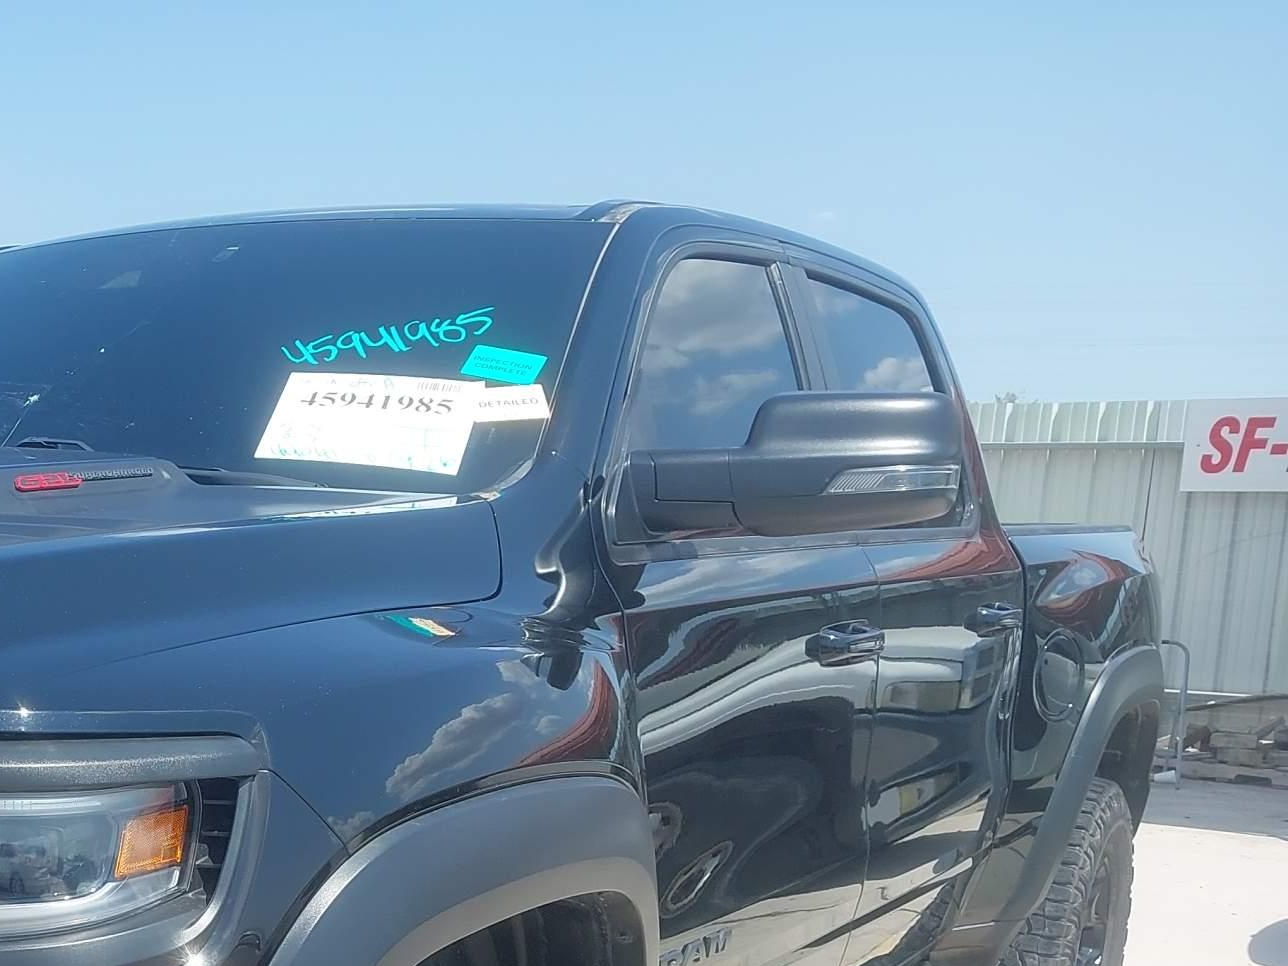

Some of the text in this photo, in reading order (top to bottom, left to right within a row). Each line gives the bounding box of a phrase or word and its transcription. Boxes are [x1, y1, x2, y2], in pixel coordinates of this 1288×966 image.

[281, 306, 495, 365] 45941985
[300, 391, 454, 415] 45941985
[478, 397, 538, 408] DETAILED
[1200, 415, 1288, 473] SF-
